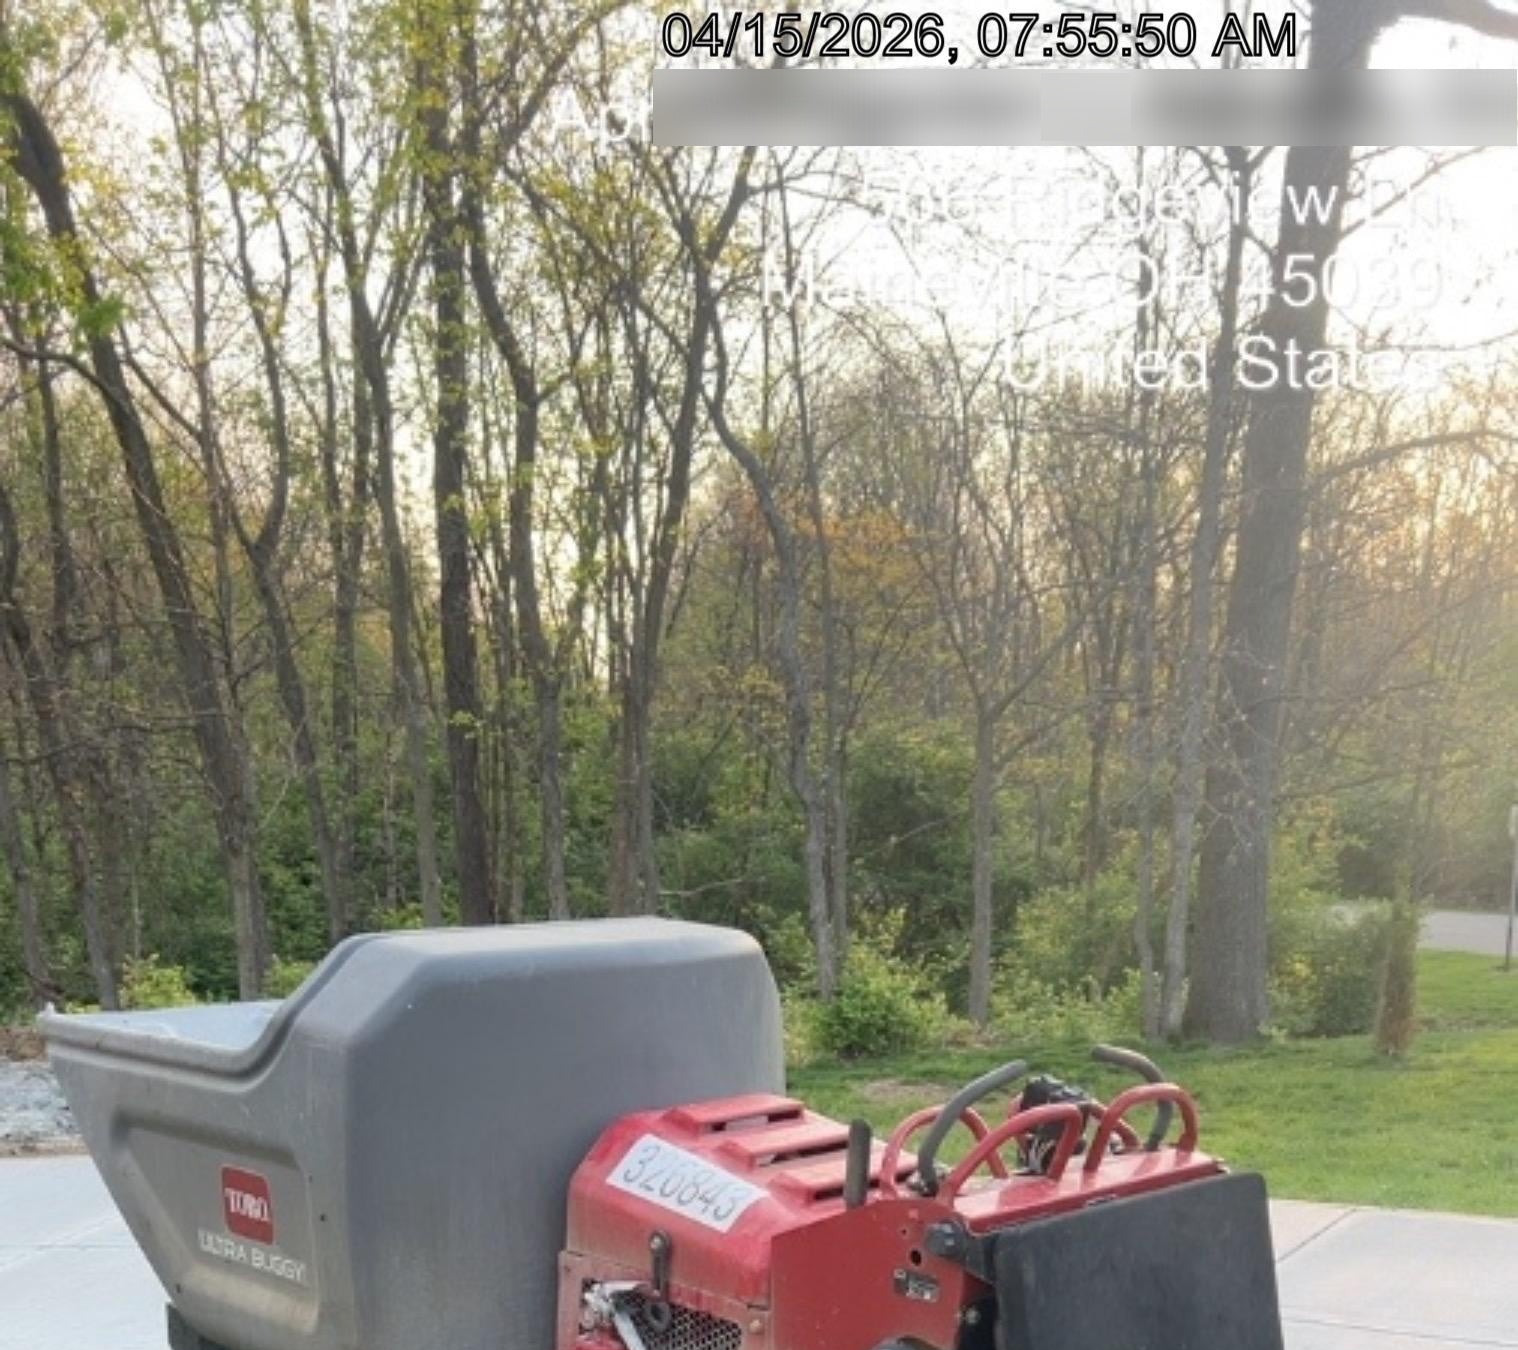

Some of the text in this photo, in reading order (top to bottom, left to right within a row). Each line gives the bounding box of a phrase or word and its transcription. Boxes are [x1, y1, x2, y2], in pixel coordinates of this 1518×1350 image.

[224, 1187, 271, 1222] TORO
[198, 1228, 306, 1282] ULTRA BUGGY
